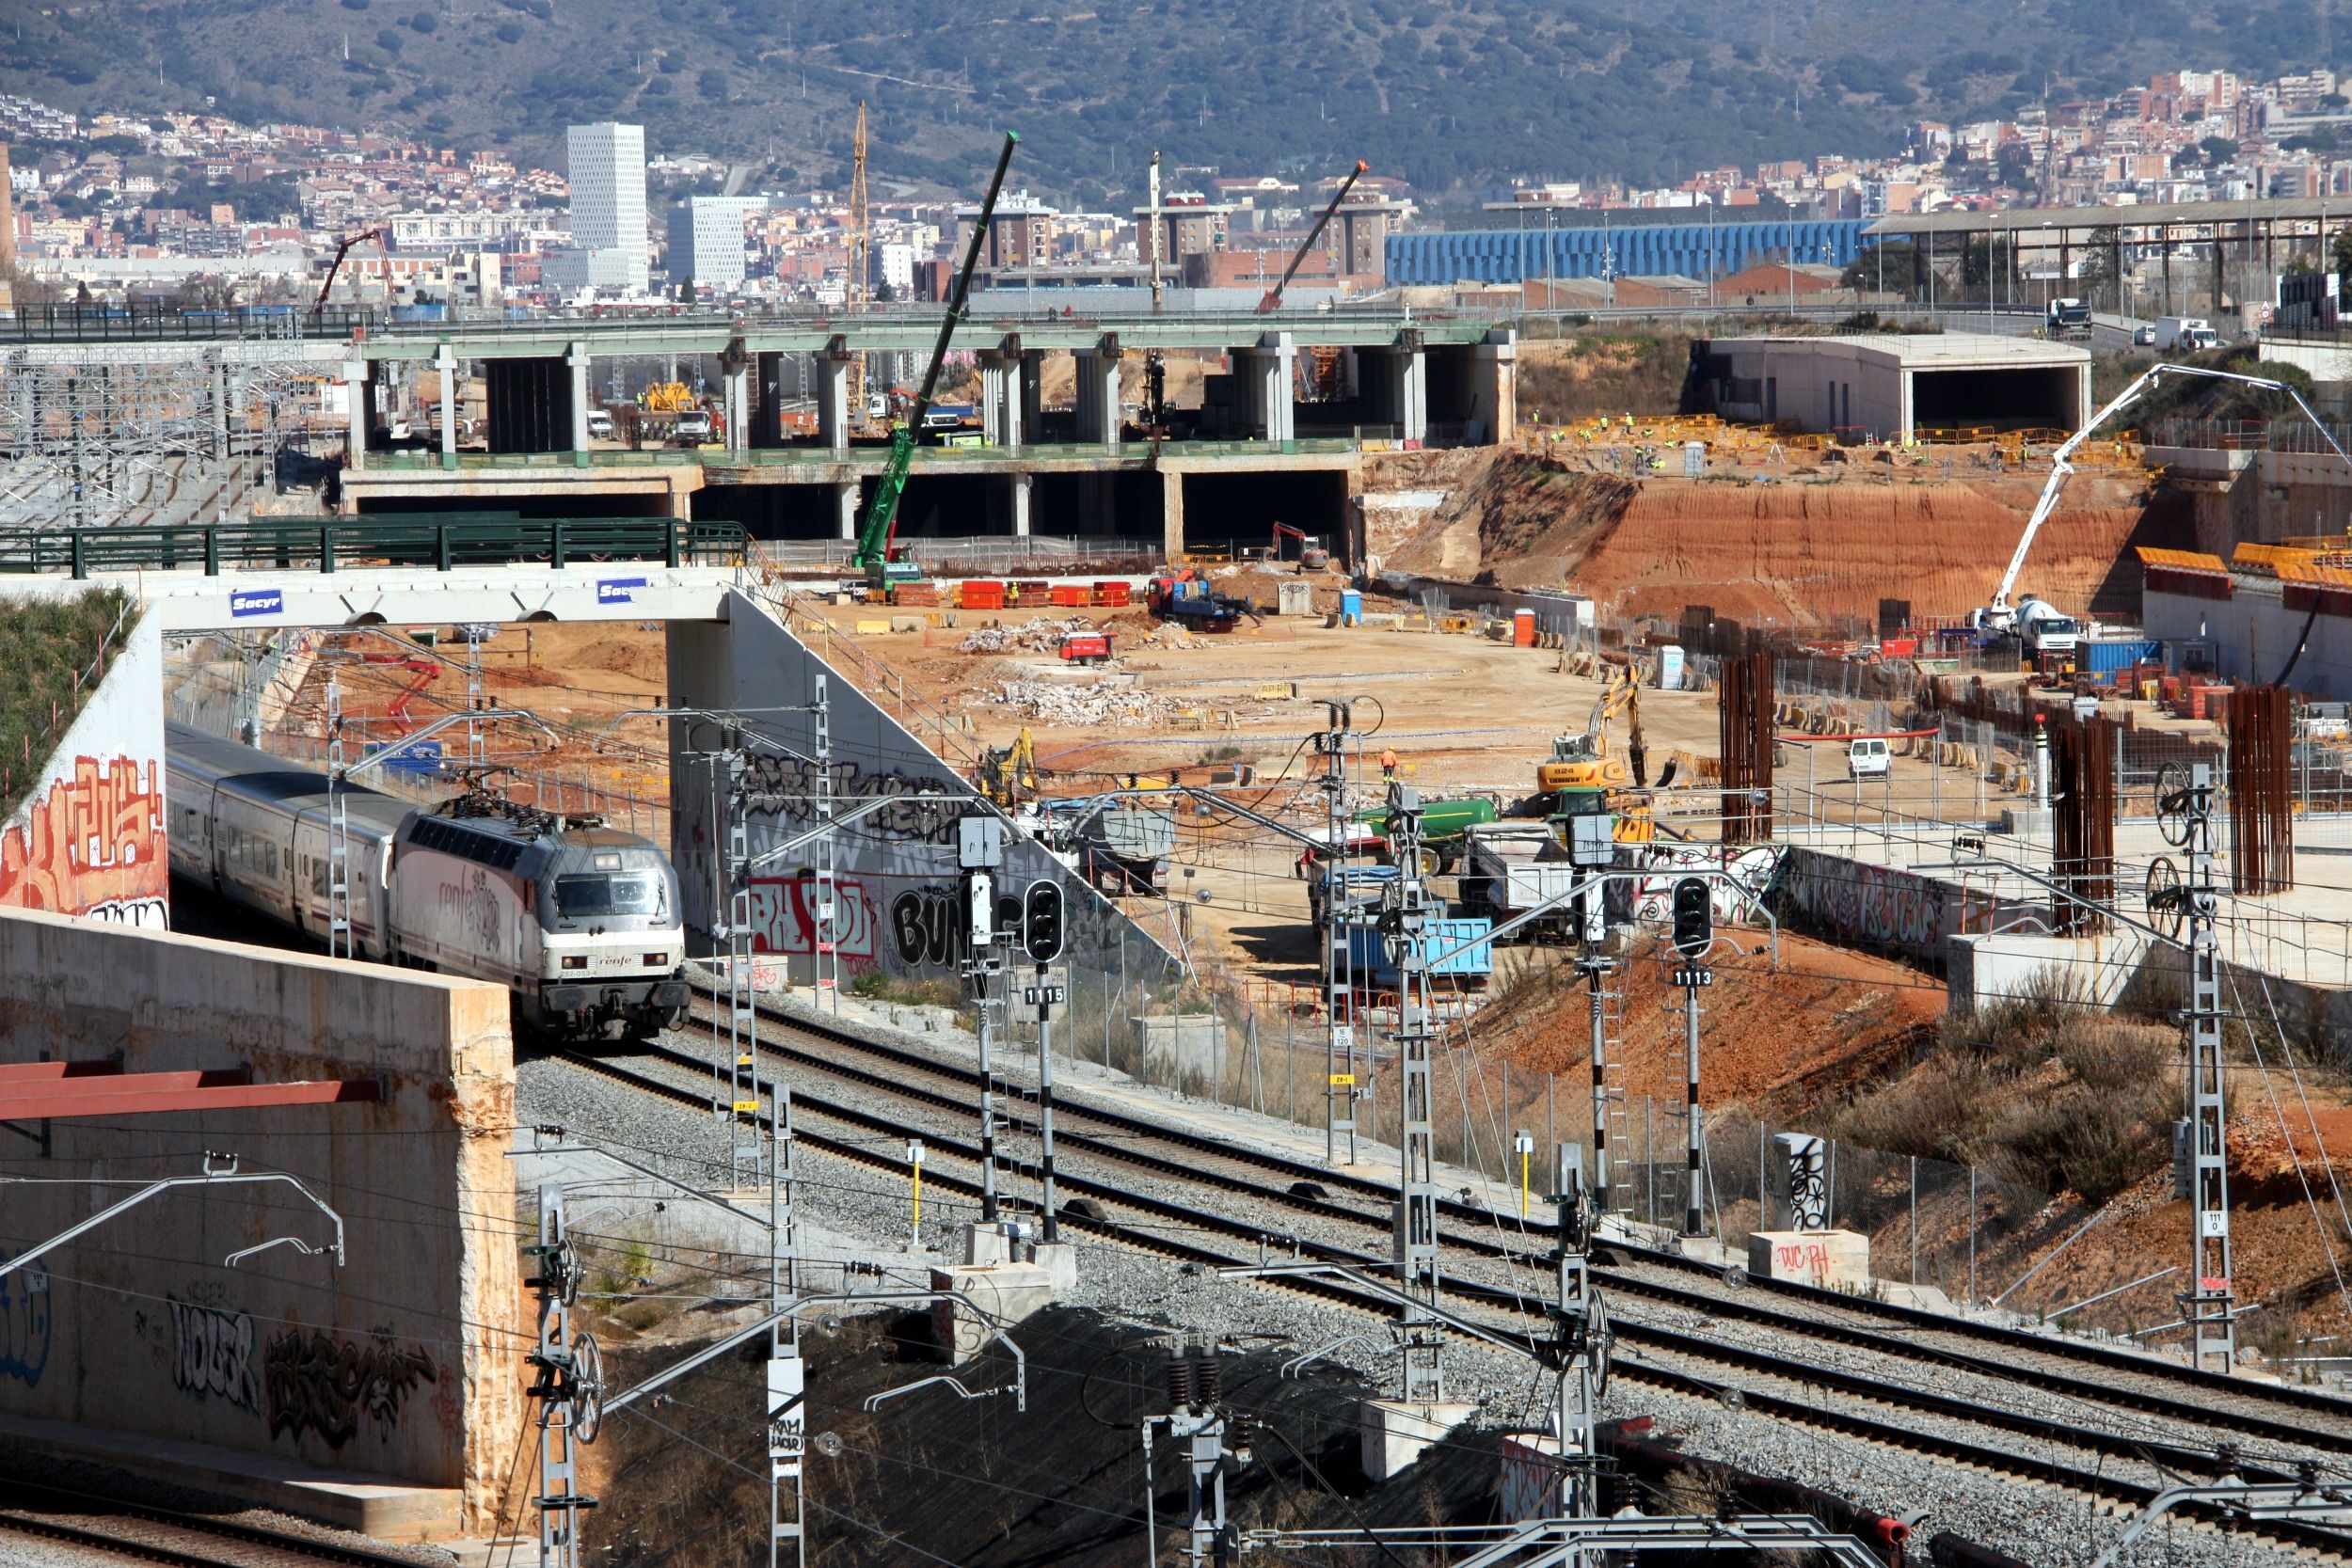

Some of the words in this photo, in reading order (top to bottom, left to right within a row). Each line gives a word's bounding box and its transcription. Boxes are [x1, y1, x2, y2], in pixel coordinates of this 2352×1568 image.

[599, 585, 645, 597] Sac
[232, 596, 280, 610] Sacyr
[599, 955, 632, 968] renfe
[1676, 972, 1711, 985] 1113
[1027, 988, 1063, 1003] 1115
[2209, 1213, 2221, 1222] 111
